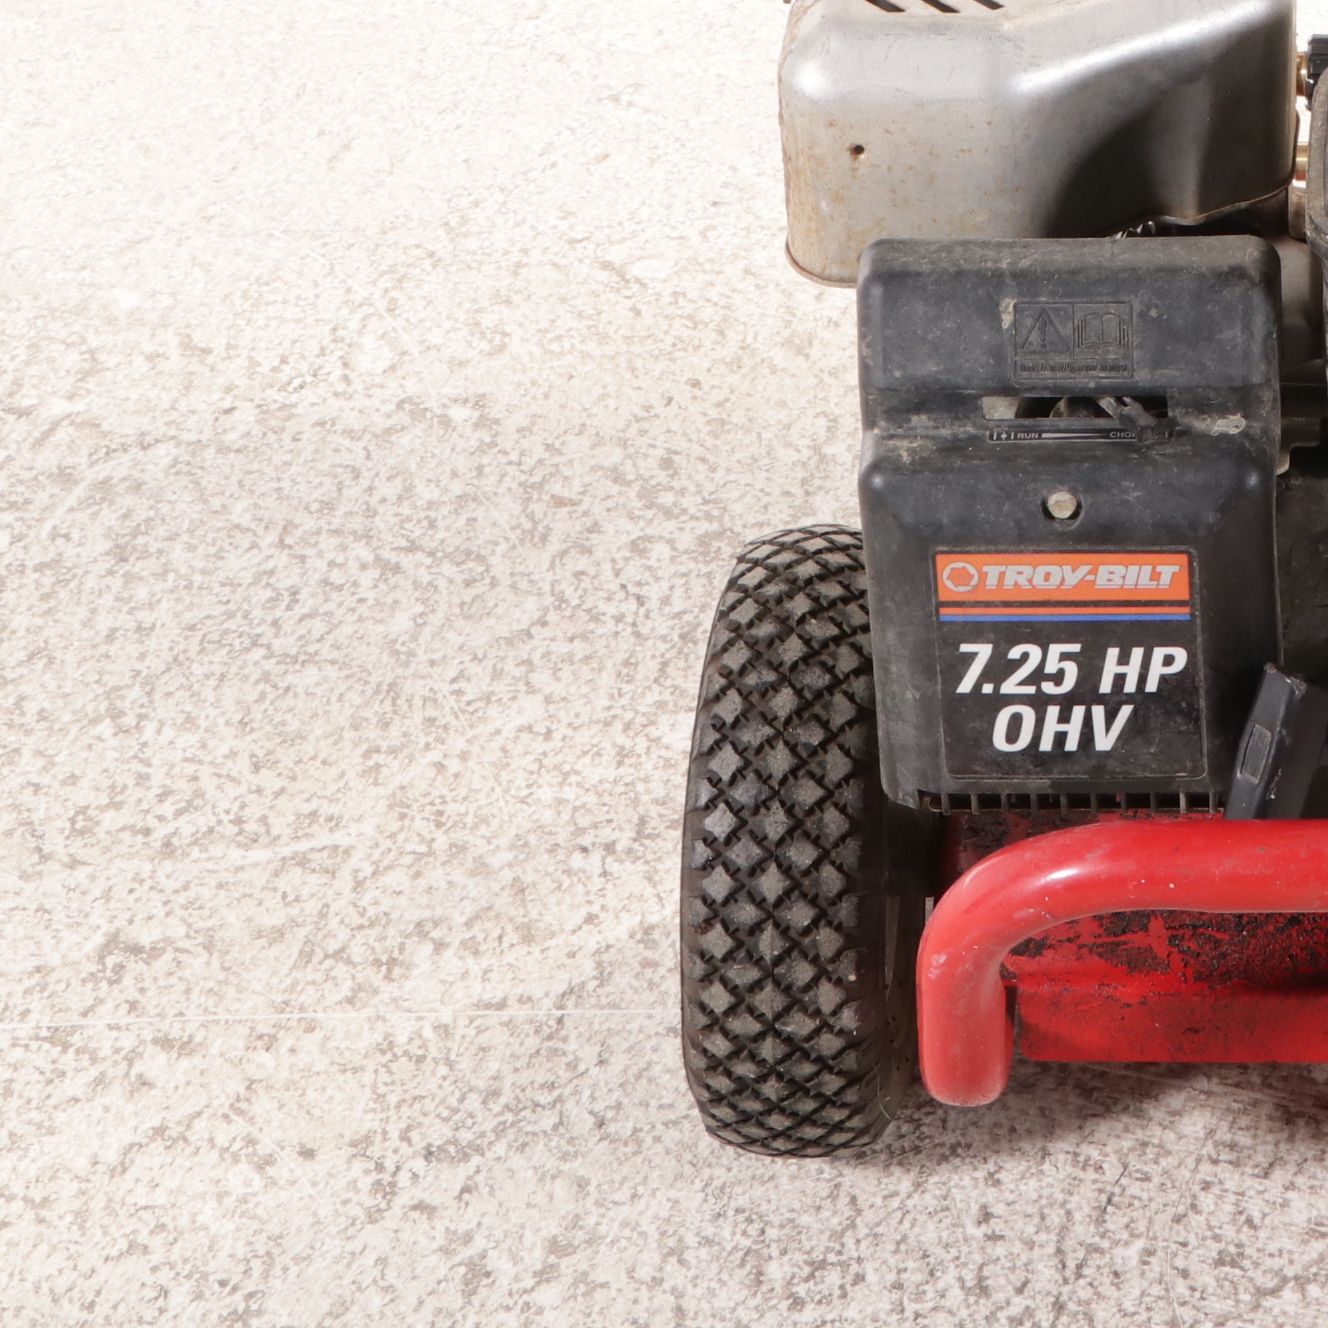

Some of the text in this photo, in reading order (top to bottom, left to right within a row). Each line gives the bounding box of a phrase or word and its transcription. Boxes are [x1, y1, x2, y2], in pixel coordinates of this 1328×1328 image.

[1110, 431, 1136, 439] CHO
[981, 565, 1180, 589] TROY-BILT
[955, 643, 1188, 695] 7.25 HP
[992, 704, 1135, 752] OHV
